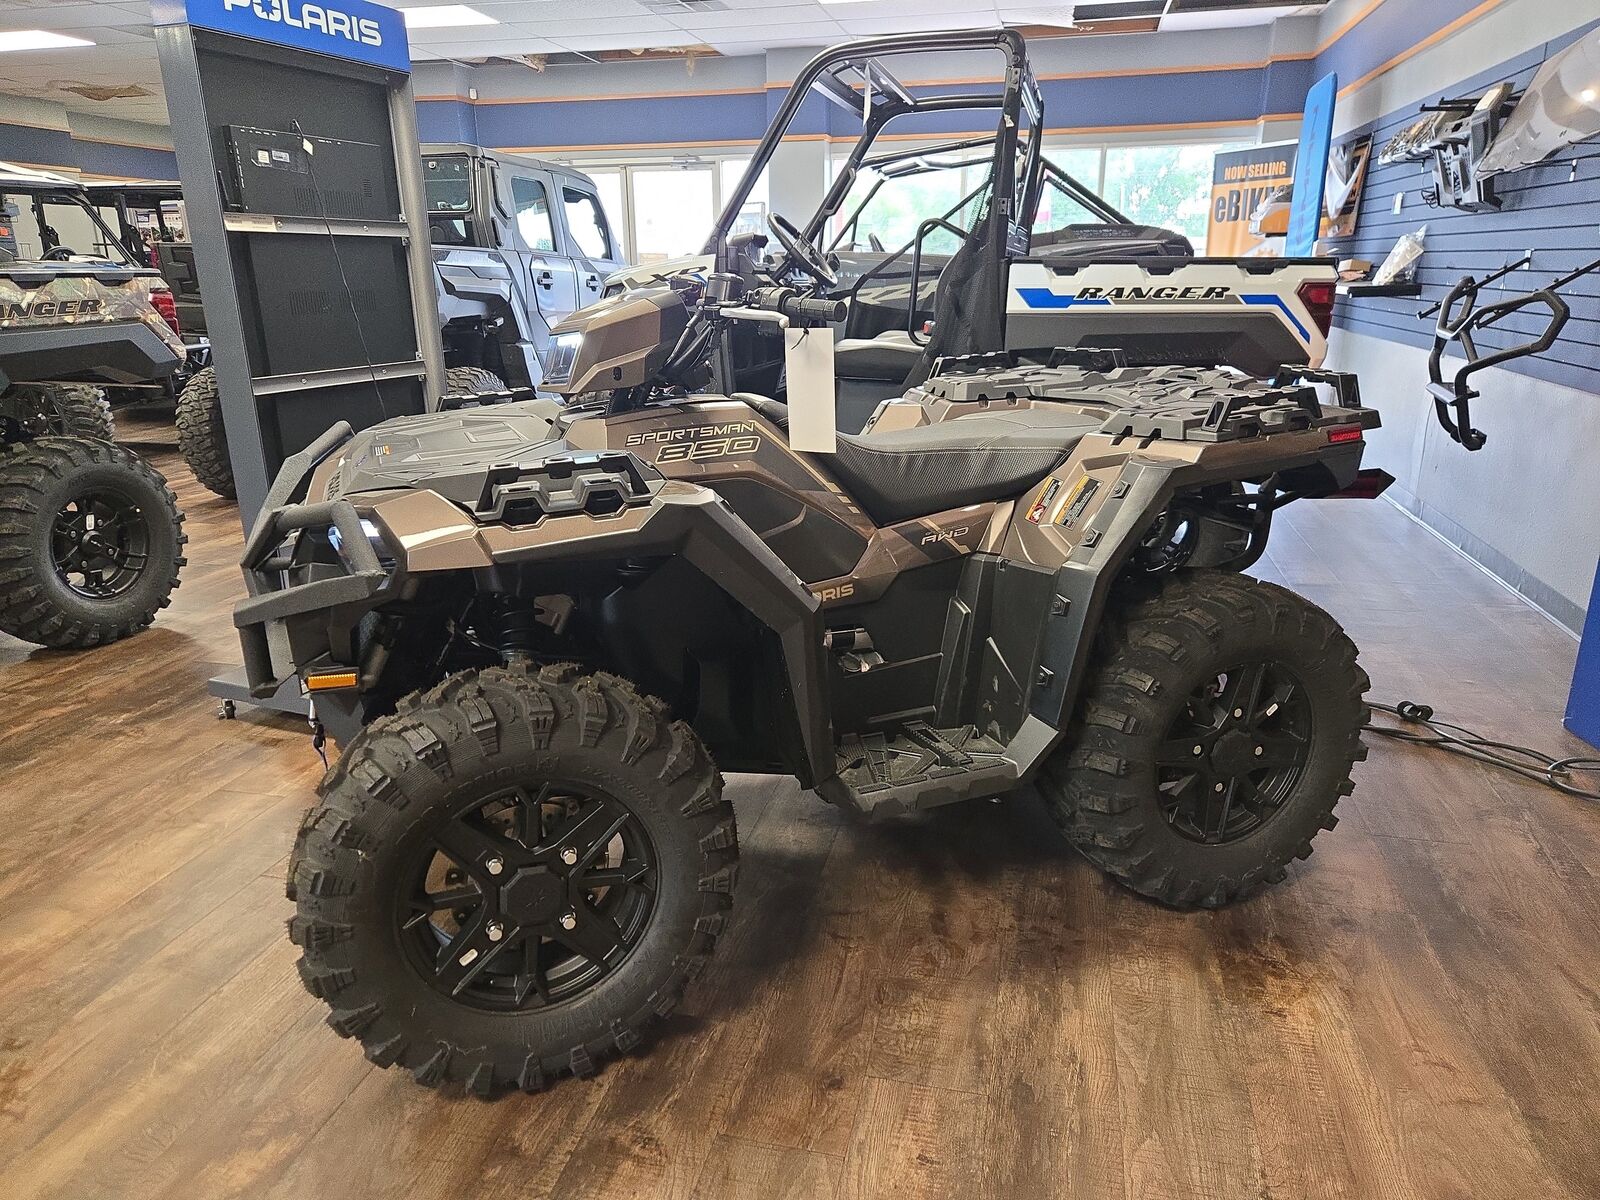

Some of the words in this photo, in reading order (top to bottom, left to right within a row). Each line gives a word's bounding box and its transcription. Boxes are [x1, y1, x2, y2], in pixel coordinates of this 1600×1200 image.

[1224, 166, 1248, 181] NOW
[1248, 161, 1287, 178] SELLING
[1075, 286, 1231, 300] RANGER
[625, 421, 756, 447] SPORTSMAN
[655, 435, 761, 465] 850
[920, 526, 970, 546] AWD
